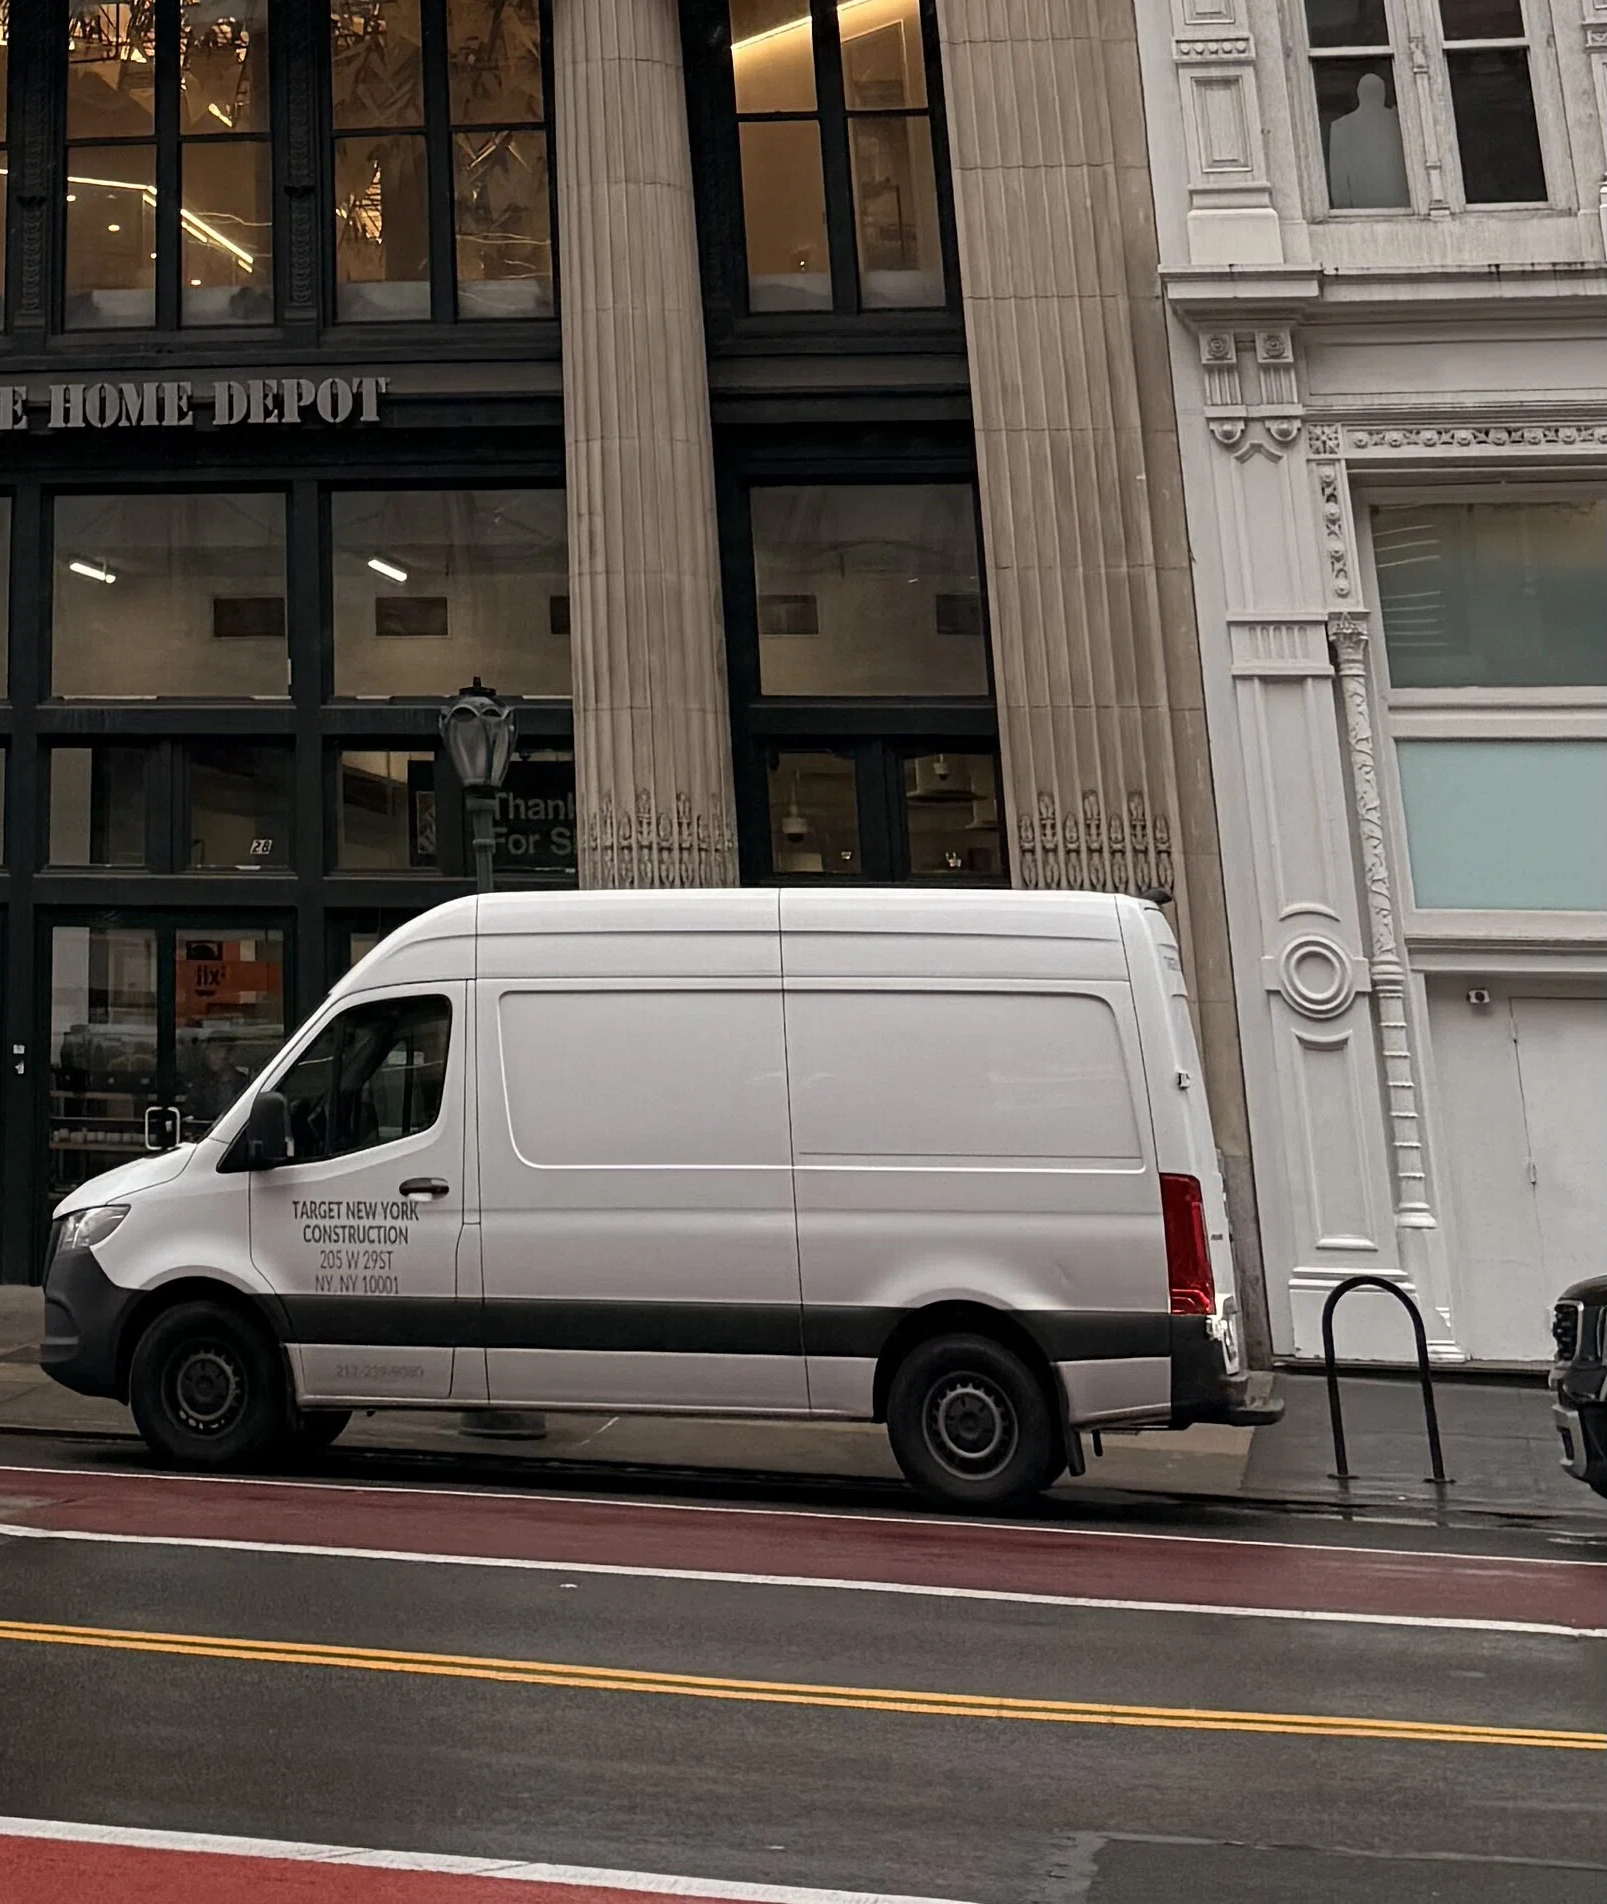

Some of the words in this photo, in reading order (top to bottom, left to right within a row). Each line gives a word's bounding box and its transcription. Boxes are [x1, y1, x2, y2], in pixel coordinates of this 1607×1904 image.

[47, 381, 194, 429] HOME
[211, 376, 392, 426] DEPOT
[251, 840, 271, 853] 28
[292, 1200, 343, 1221] TARGET
[346, 1200, 378, 1221] NEW
[380, 1201, 420, 1222] YORK
[303, 1224, 409, 1245] CONSTRUCTION
[320, 1250, 343, 1270] 205
[346, 1250, 360, 1270] W
[363, 1250, 394, 1271] 29ST
[340, 1275, 359, 1293] NY
[362, 1275, 400, 1295] 10001
